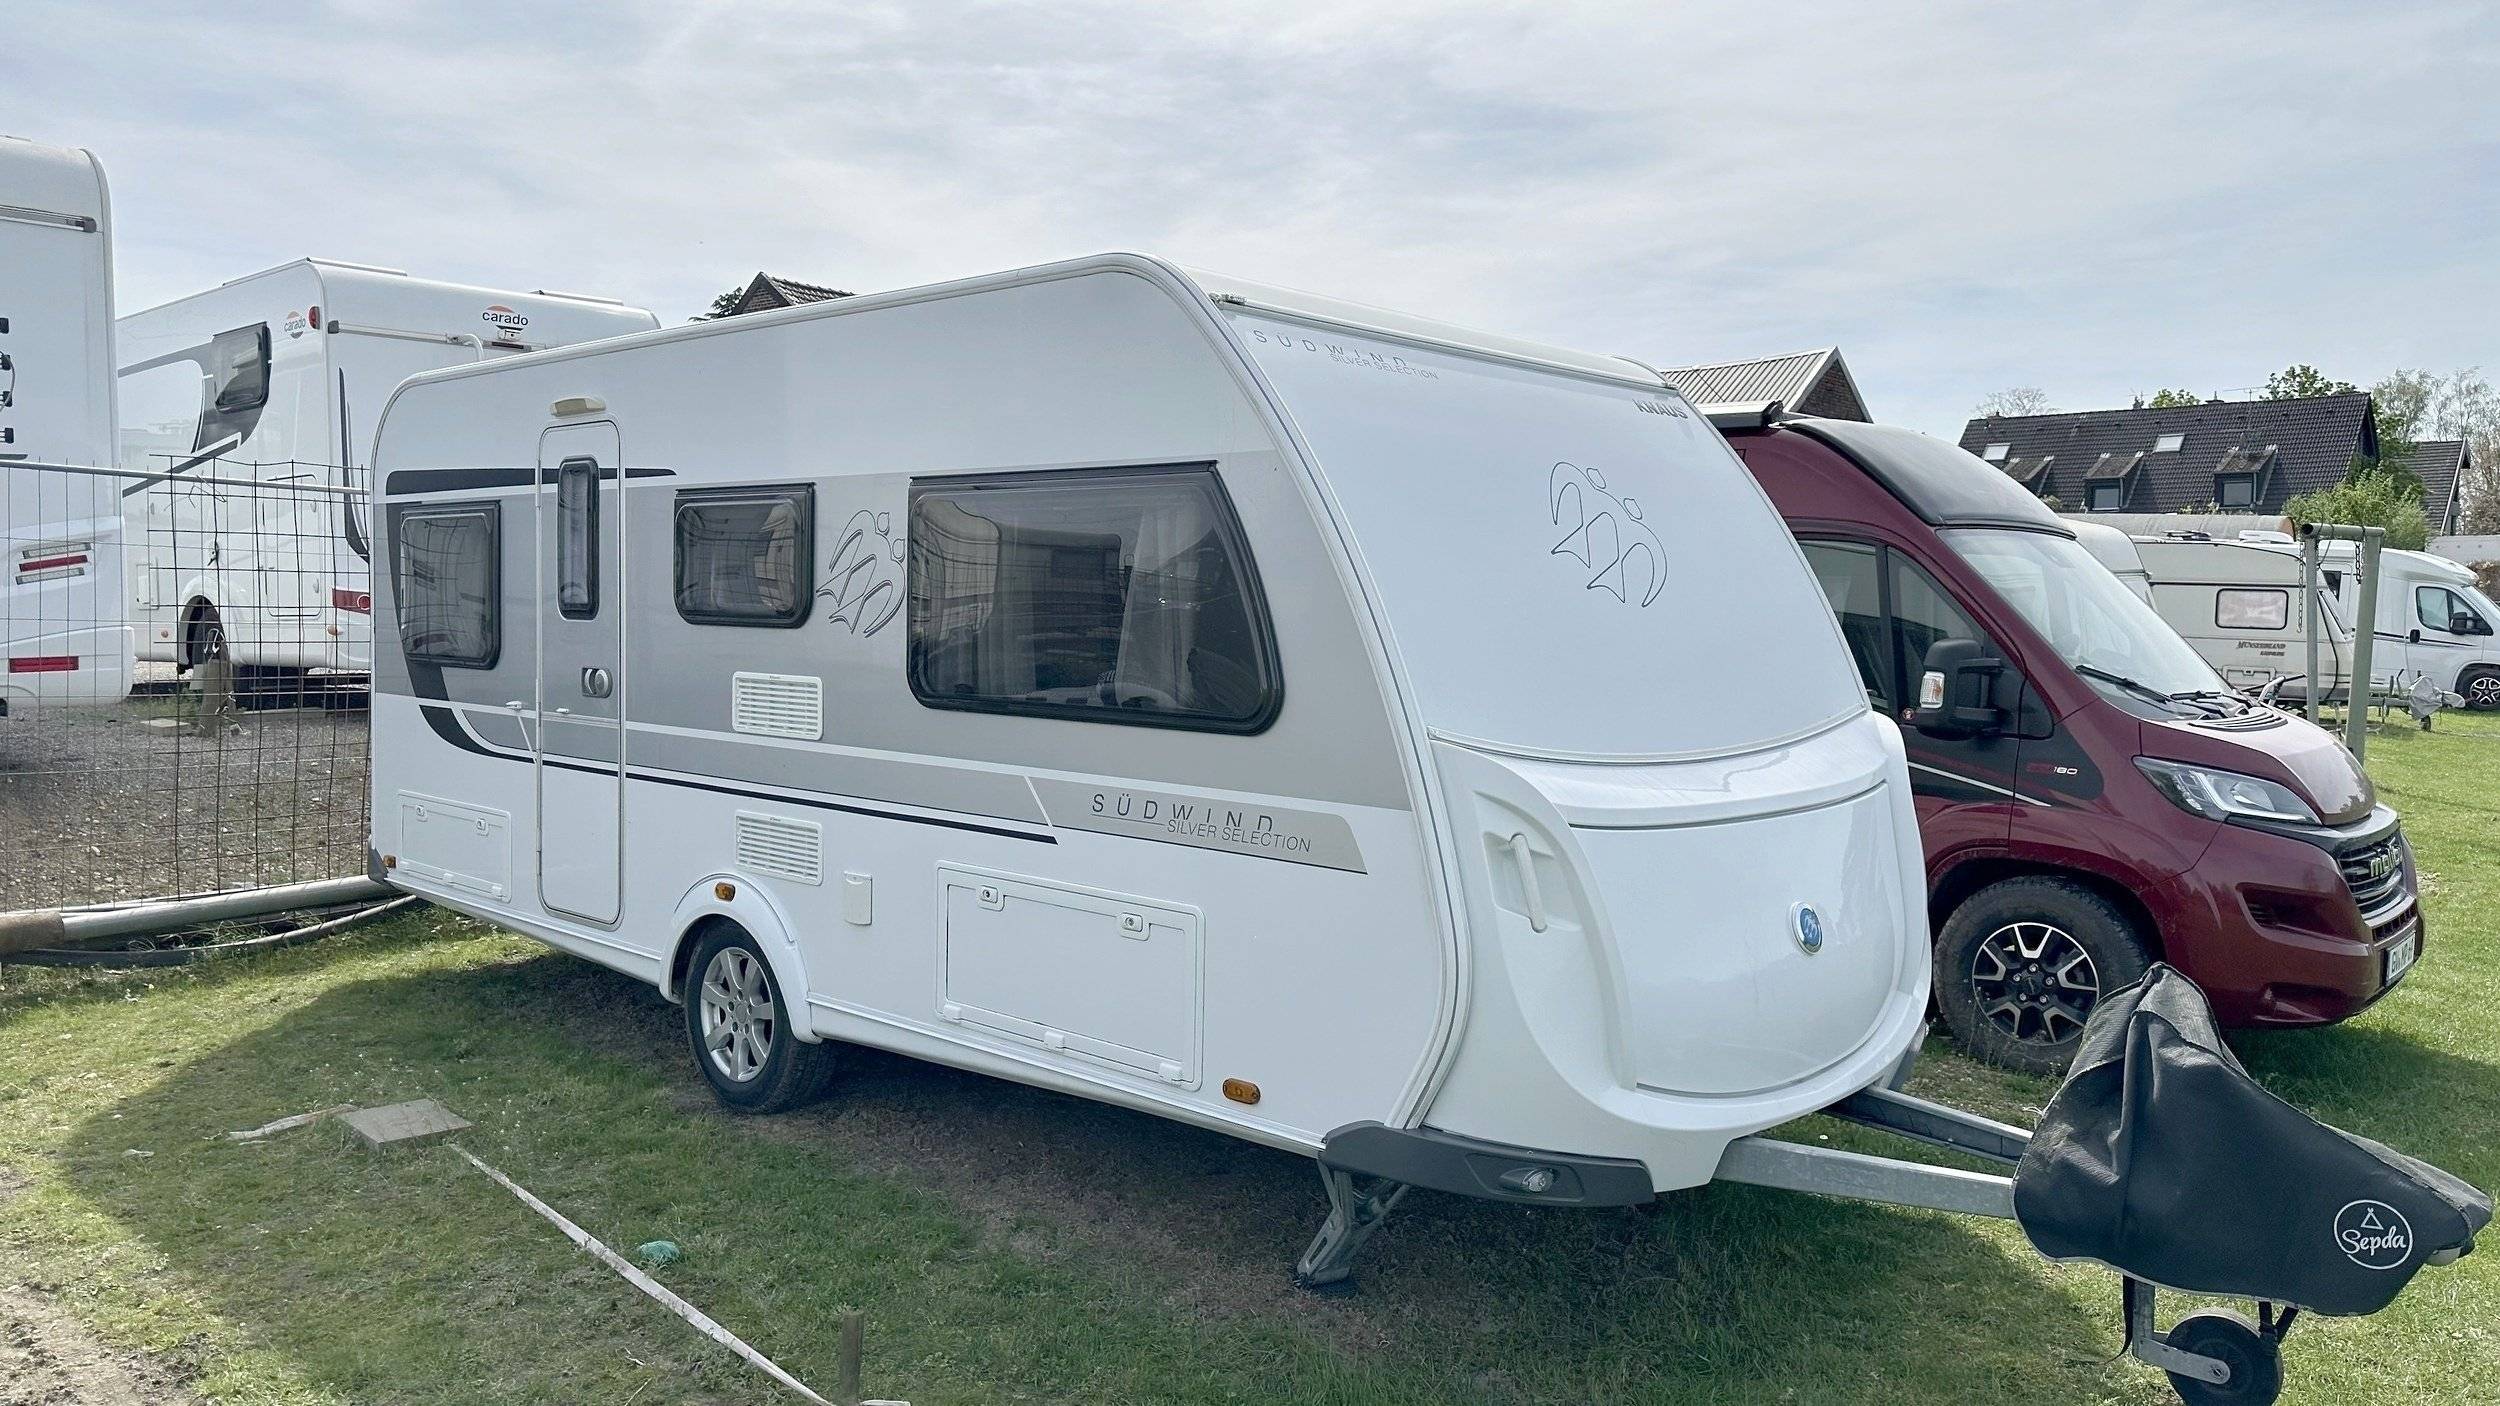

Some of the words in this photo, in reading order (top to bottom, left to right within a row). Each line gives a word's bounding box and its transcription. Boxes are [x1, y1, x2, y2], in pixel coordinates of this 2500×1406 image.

[482, 312, 529, 326] carado
[1329, 353, 1372, 369] SILVER
[1374, 361, 1440, 380] SELECTION
[1631, 398, 1689, 419] KNAUS
[1091, 793, 1274, 833] SÜDWIND
[1166, 819, 1217, 839] SILVER
[1221, 827, 1312, 853] SELECTION
[2341, 1225, 2407, 1257] Sepda
